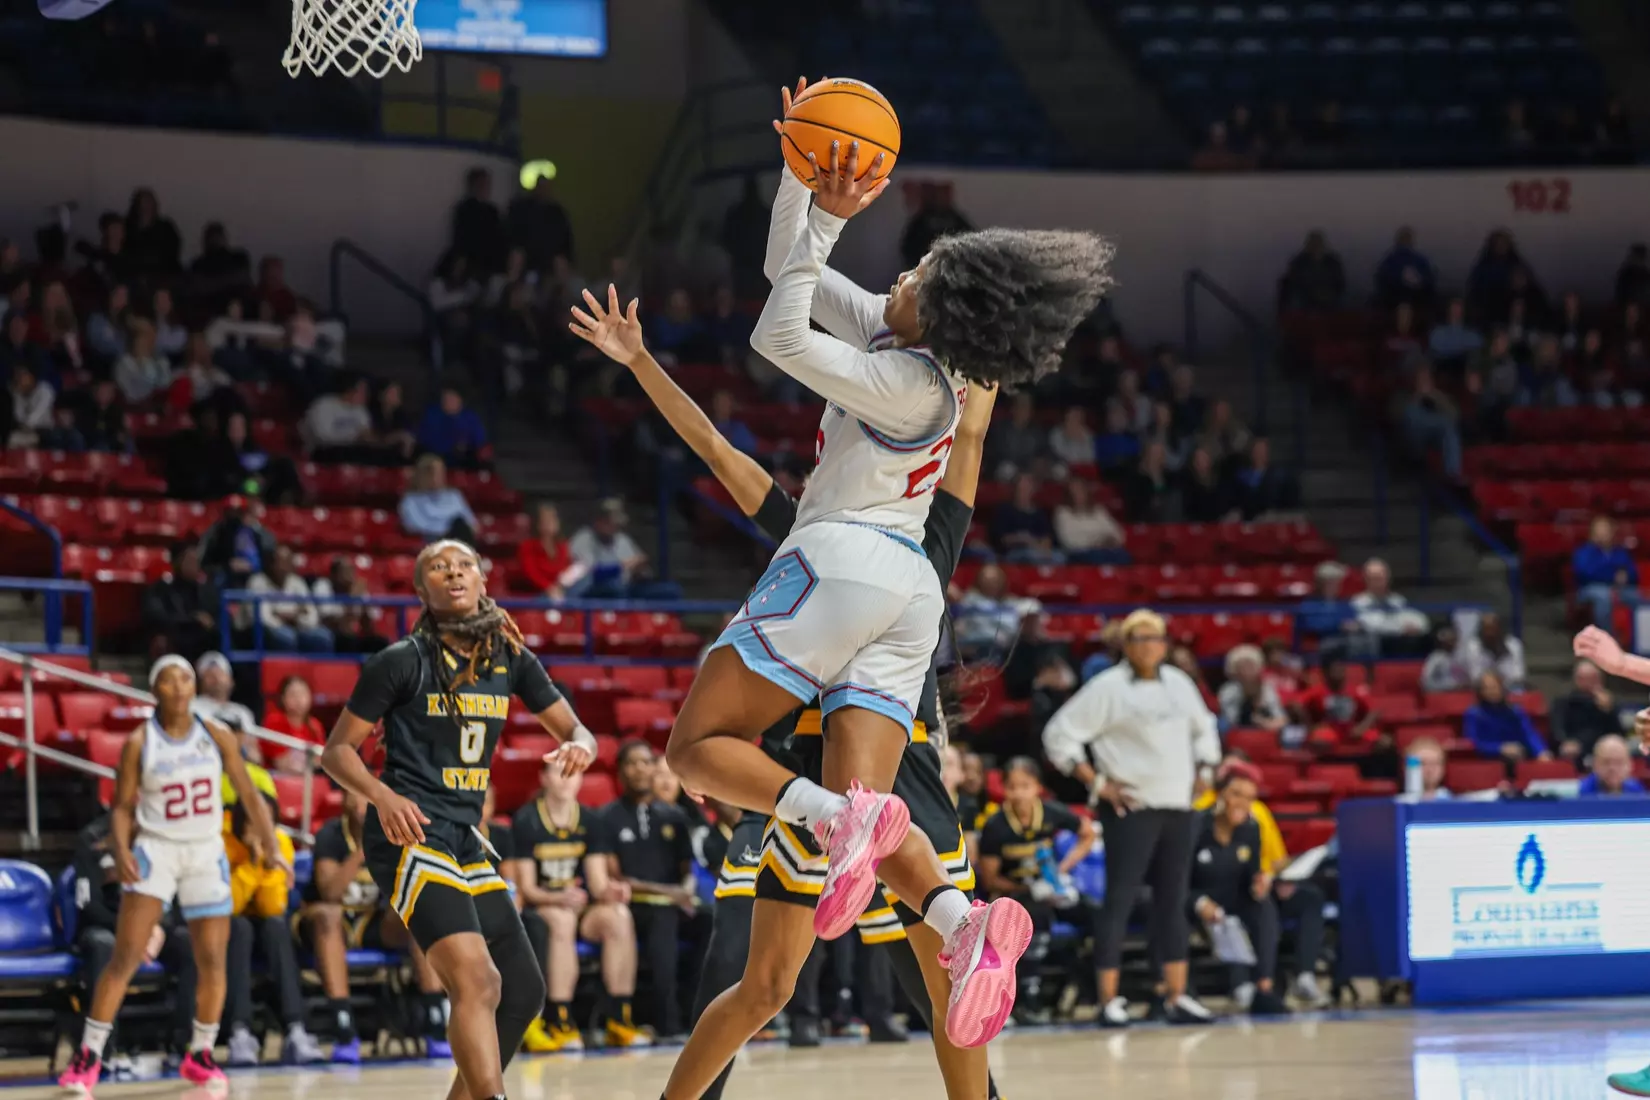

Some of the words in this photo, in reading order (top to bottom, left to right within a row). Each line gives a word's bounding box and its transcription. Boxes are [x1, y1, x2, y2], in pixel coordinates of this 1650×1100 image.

[1505, 178, 1571, 213] 102
[460, 721, 486, 763] 0
[442, 767, 490, 791] STAT
[162, 778, 213, 819] 22
